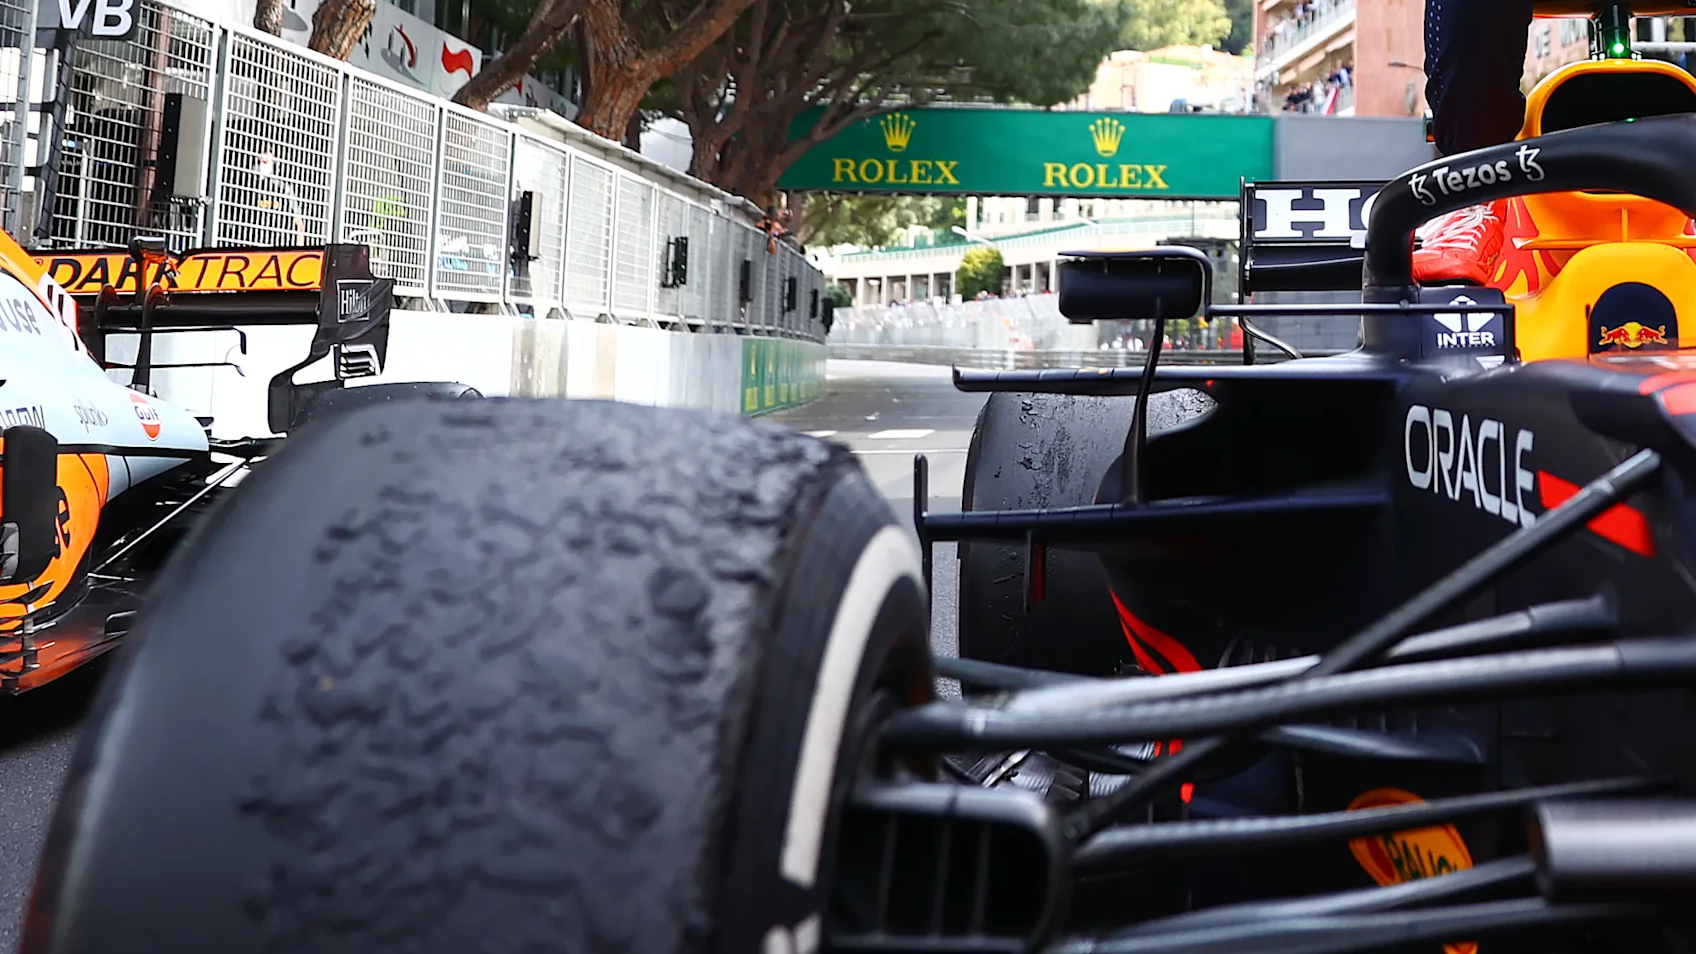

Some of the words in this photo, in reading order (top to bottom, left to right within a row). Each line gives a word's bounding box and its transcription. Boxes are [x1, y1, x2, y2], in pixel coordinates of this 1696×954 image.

[832, 157, 960, 186] ROLEX
[1043, 161, 1170, 190] ROLEX
[1432, 158, 1512, 197] Tezos
[47, 254, 323, 290] DARKTRAC
[1437, 331, 1496, 347] INTER
[134, 405, 160, 421] Gulf
[1404, 404, 1537, 529] ORACLE
